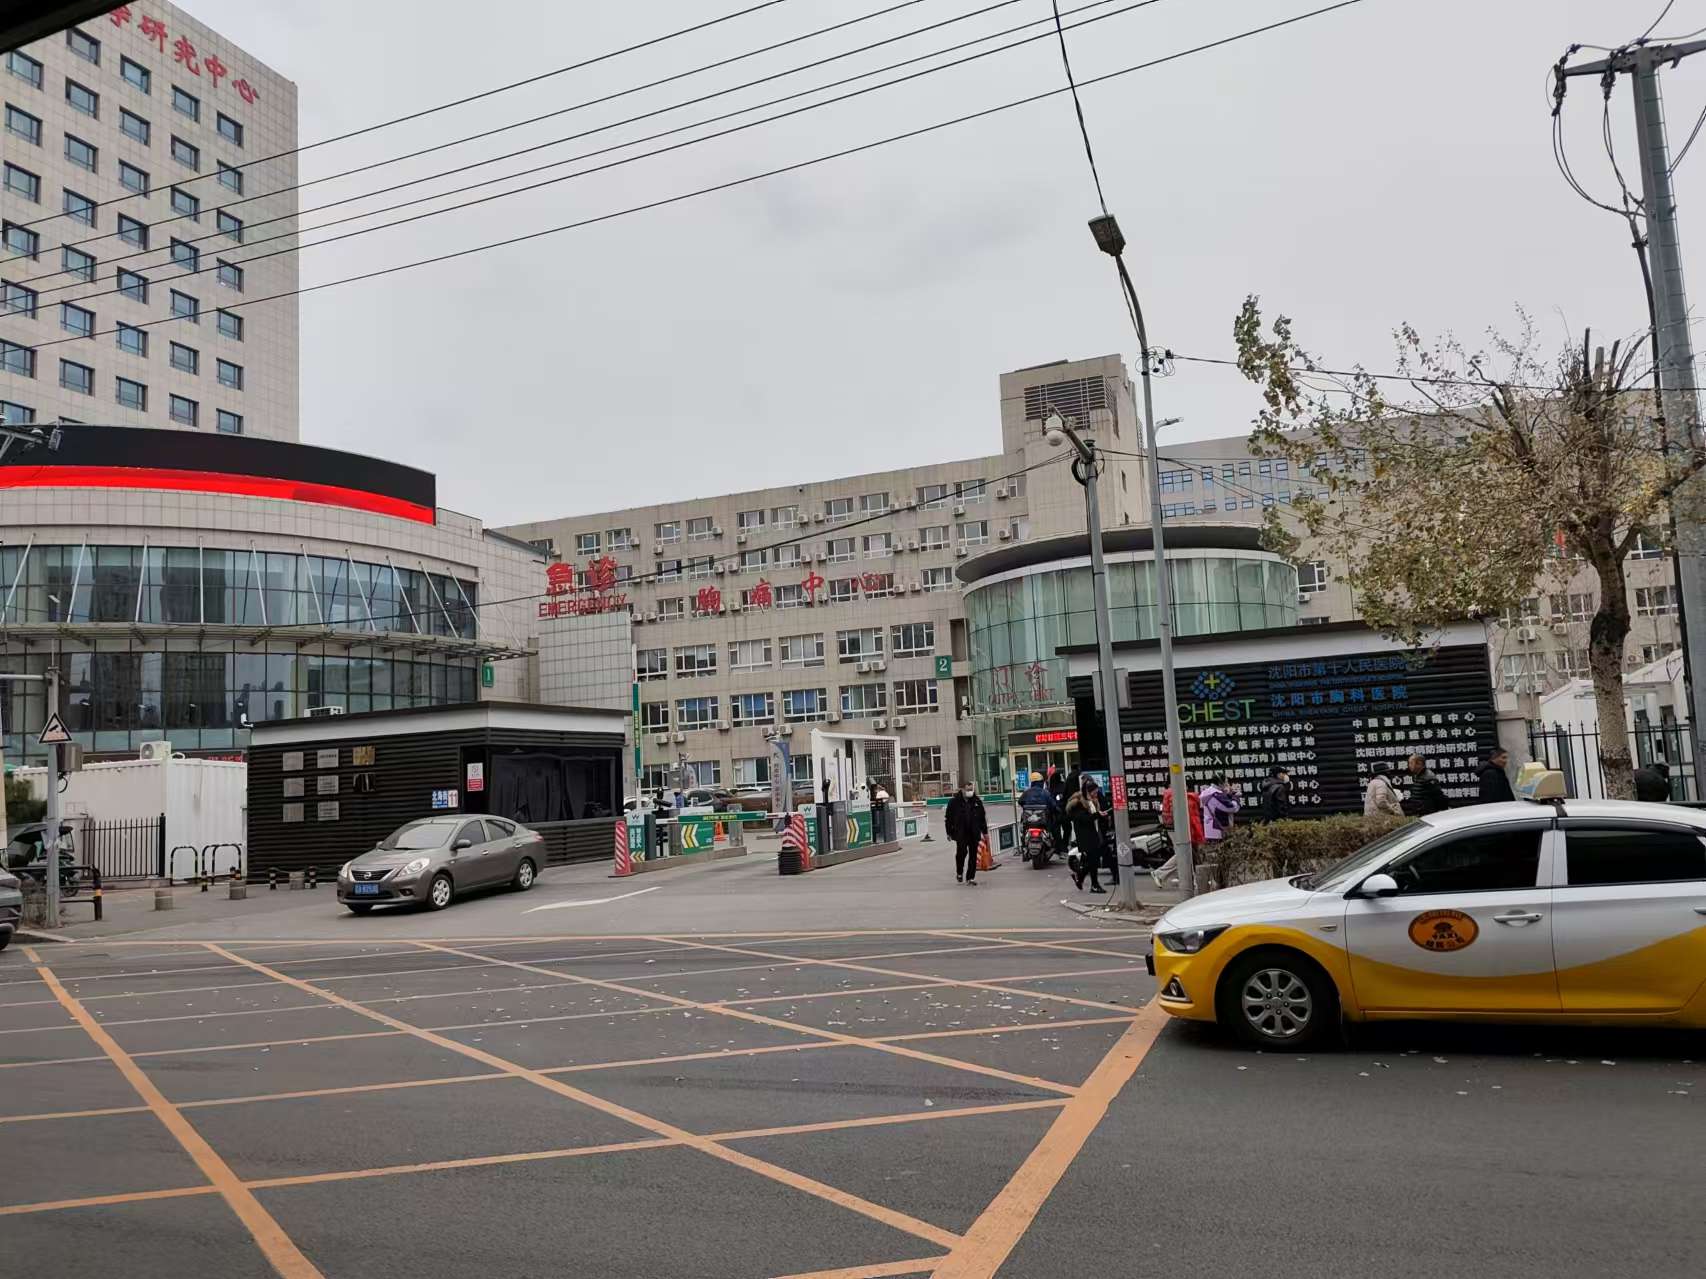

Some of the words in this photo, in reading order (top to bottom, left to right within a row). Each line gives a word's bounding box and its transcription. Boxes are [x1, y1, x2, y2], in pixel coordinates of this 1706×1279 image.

[546, 556, 618, 596] 急诊
[939, 658, 948, 672] 2
[1177, 699, 1256, 723] CHEST
[1122, 723, 1314, 743] 国家感染病临床医学研究中心分中心
[1124, 736, 1315, 756] 国家传染医学中心临床研究基地
